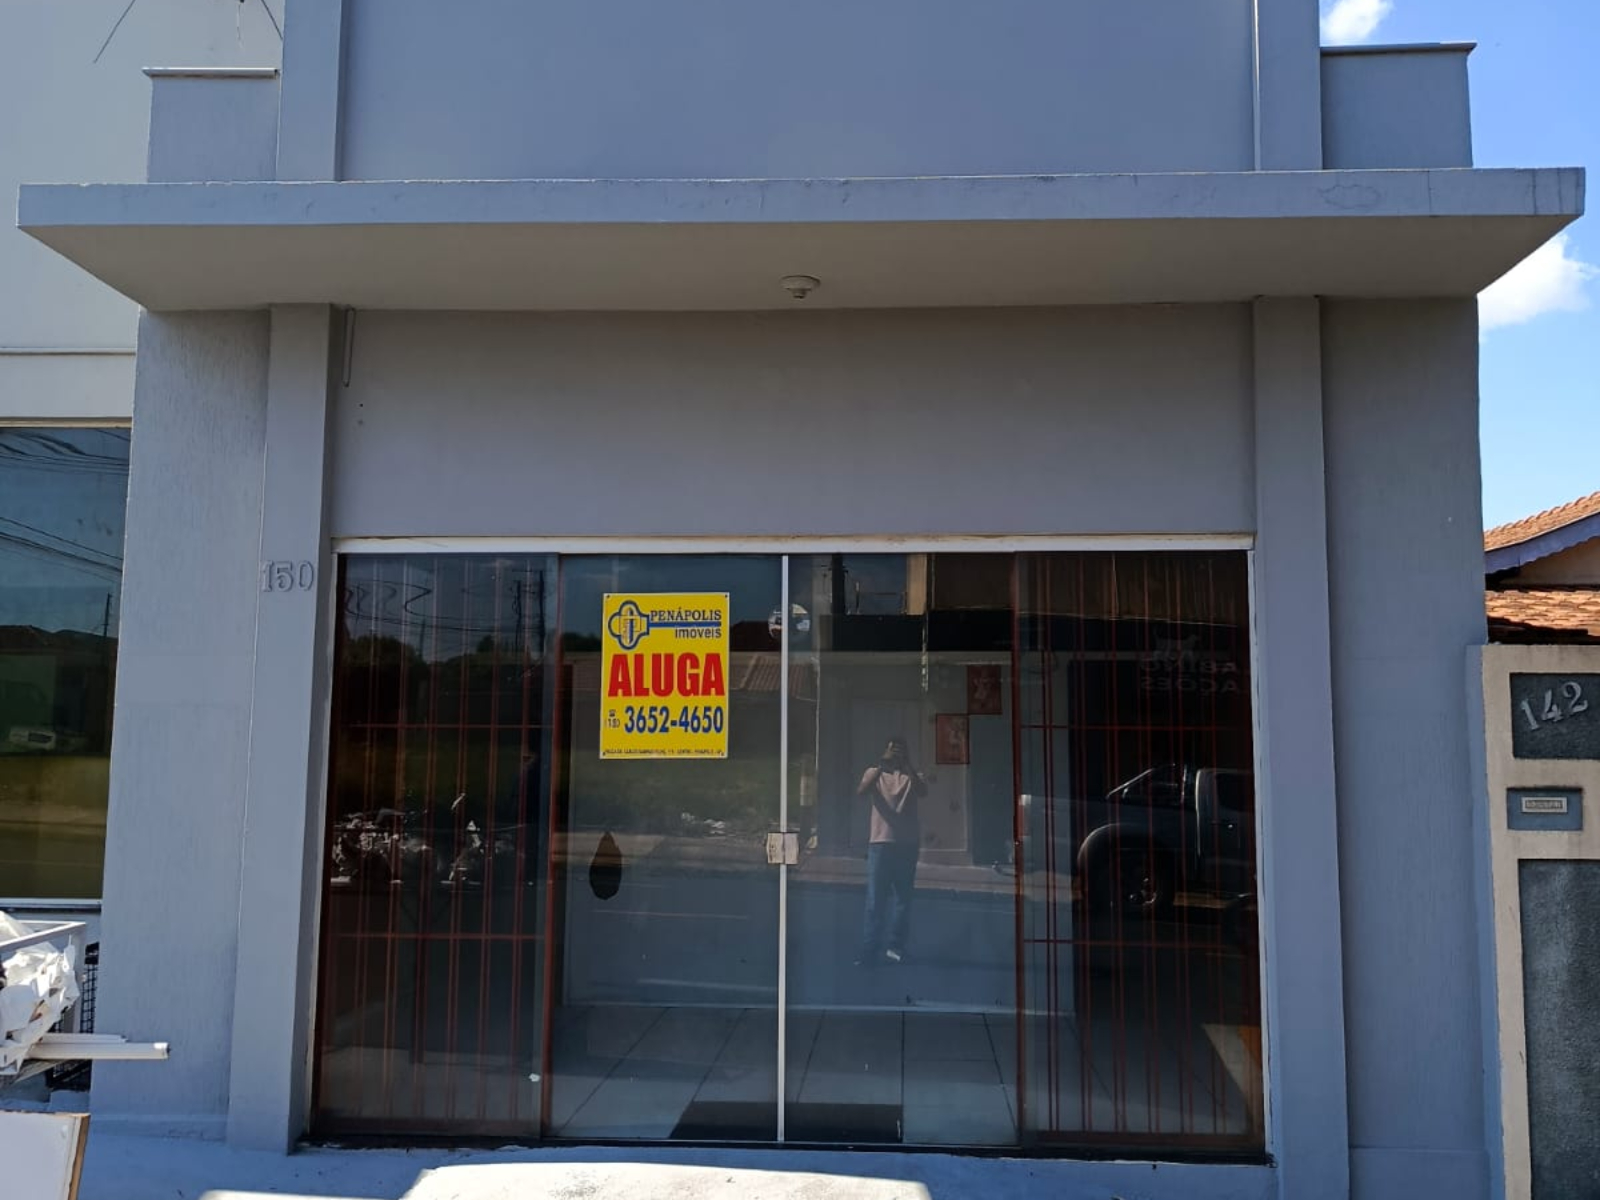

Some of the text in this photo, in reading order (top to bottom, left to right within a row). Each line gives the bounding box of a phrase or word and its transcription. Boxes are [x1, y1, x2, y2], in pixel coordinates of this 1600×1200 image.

[261, 560, 314, 592] 150
[650, 606, 723, 621] PENÁPOLIS
[608, 652, 725, 697] ALUGA
[625, 706, 723, 733] 3652-4650
[1520, 681, 1588, 730] 142
